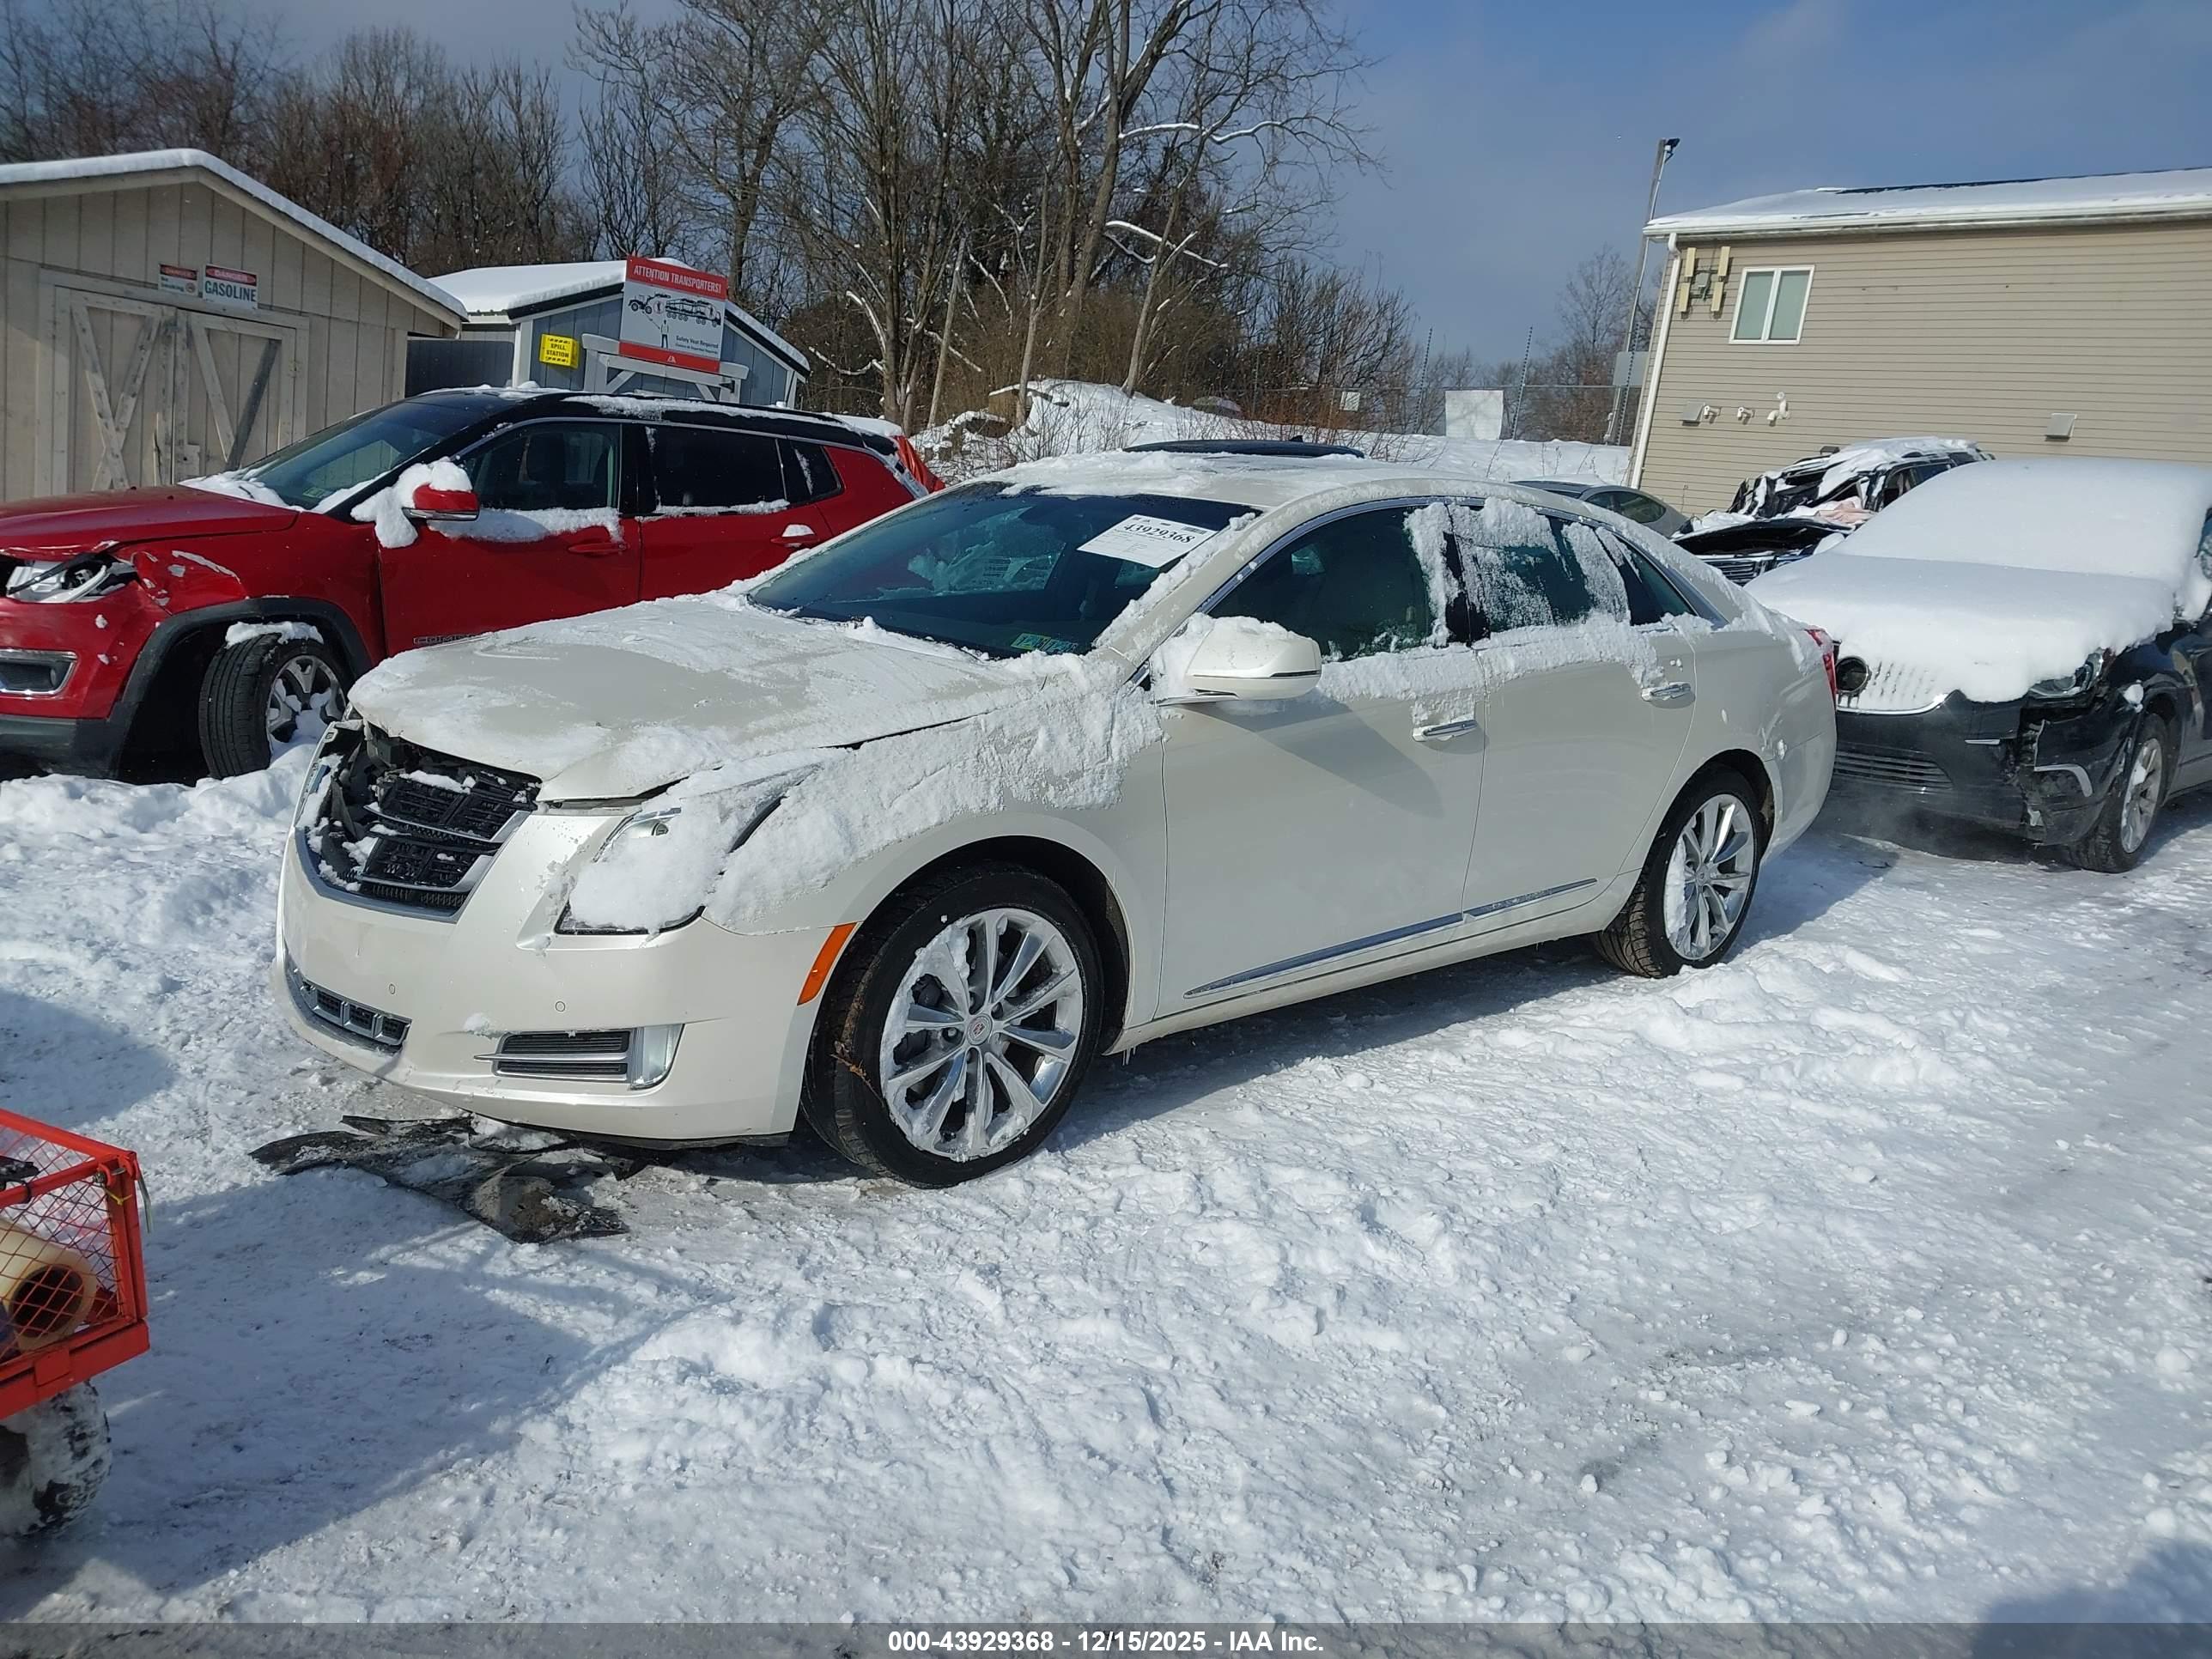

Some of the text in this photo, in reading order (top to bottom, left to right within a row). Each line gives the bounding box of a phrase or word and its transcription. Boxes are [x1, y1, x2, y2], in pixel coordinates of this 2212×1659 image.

[633, 265, 722, 294] ATTENTION TRANSPORTERS!
[205, 280, 257, 302] GASOLINE
[546, 349, 569, 358] STATION
[1123, 523, 1196, 544] 43929368
